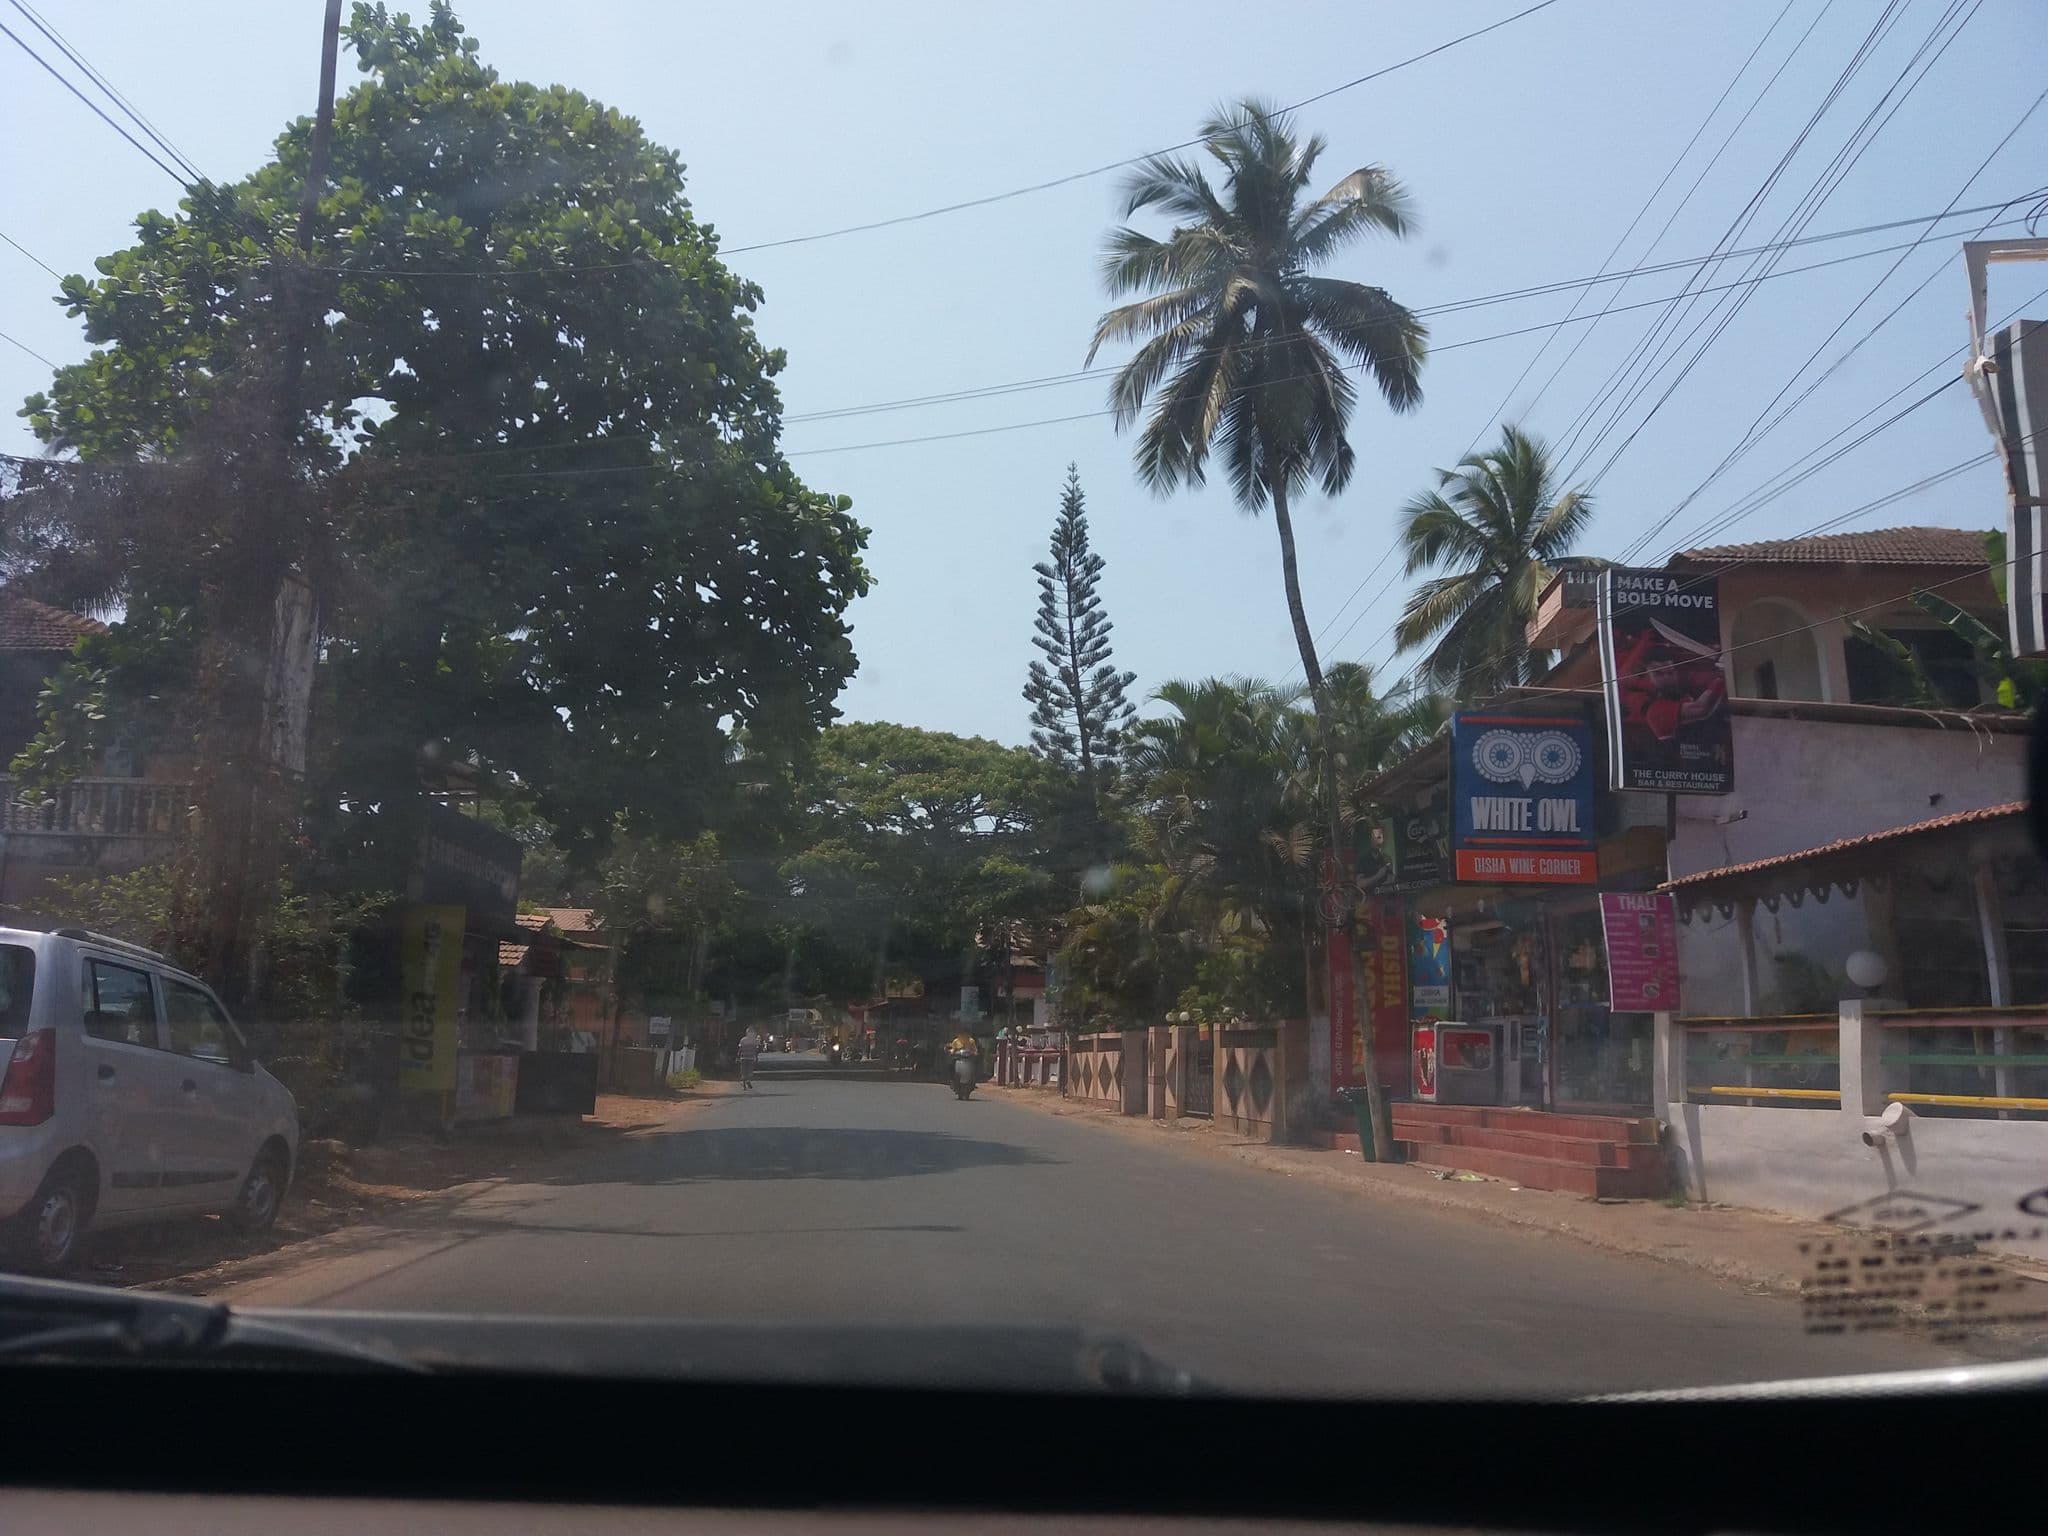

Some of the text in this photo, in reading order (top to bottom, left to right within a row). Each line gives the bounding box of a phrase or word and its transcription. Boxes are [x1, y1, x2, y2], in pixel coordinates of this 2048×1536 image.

[1617, 576, 1679, 592] MAKE A
[1617, 592, 1714, 609] BOLD MOVE
[1633, 769, 1726, 782] THE CURRY HOUSE
[1638, 779, 1655, 787] BAR
[1666, 780, 1720, 790] RESTAURANT
[1471, 797, 1532, 832] WHITE
[1538, 798, 1581, 833] OWL
[1474, 857, 1581, 875] DISHA WINE CORNER
[1617, 895, 1657, 911] THALI
[1381, 936, 1401, 1008] DISHA
